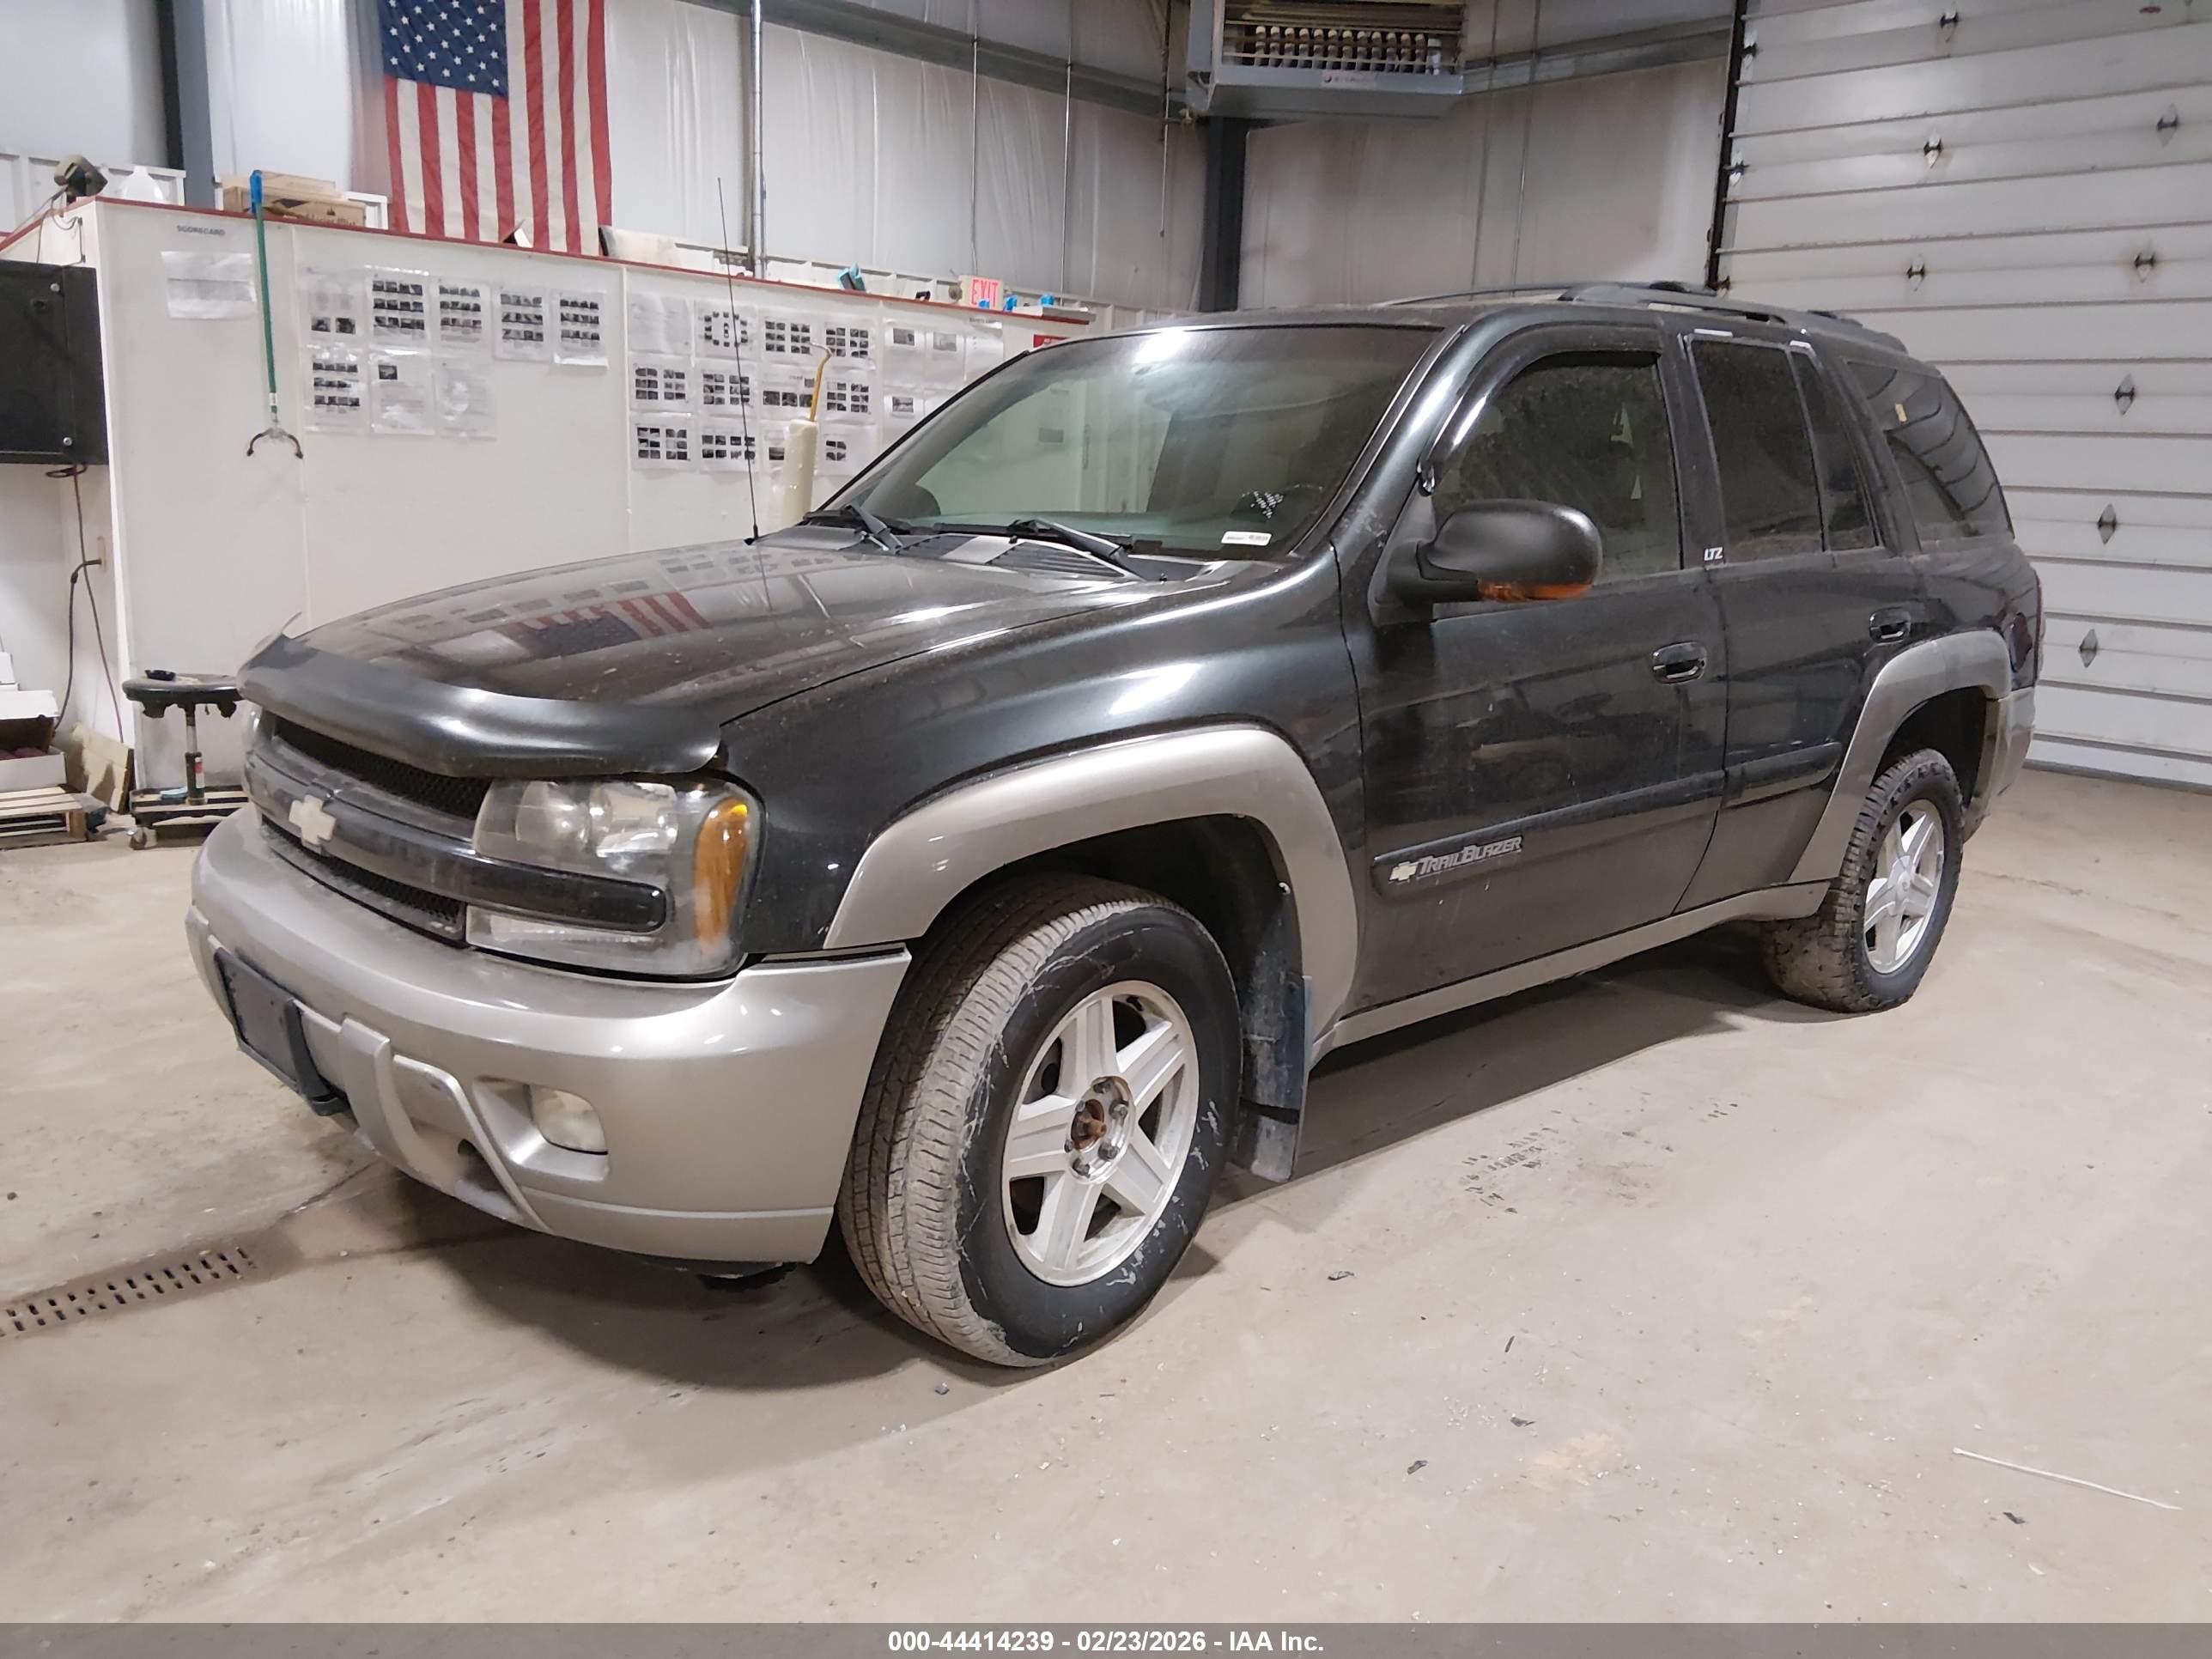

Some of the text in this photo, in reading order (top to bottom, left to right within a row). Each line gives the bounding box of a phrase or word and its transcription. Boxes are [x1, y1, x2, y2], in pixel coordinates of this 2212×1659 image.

[971, 279, 999, 307] EXIT
[1704, 546, 1723, 561] LTZ
[1419, 836, 1522, 875] TRAILBLAZER
